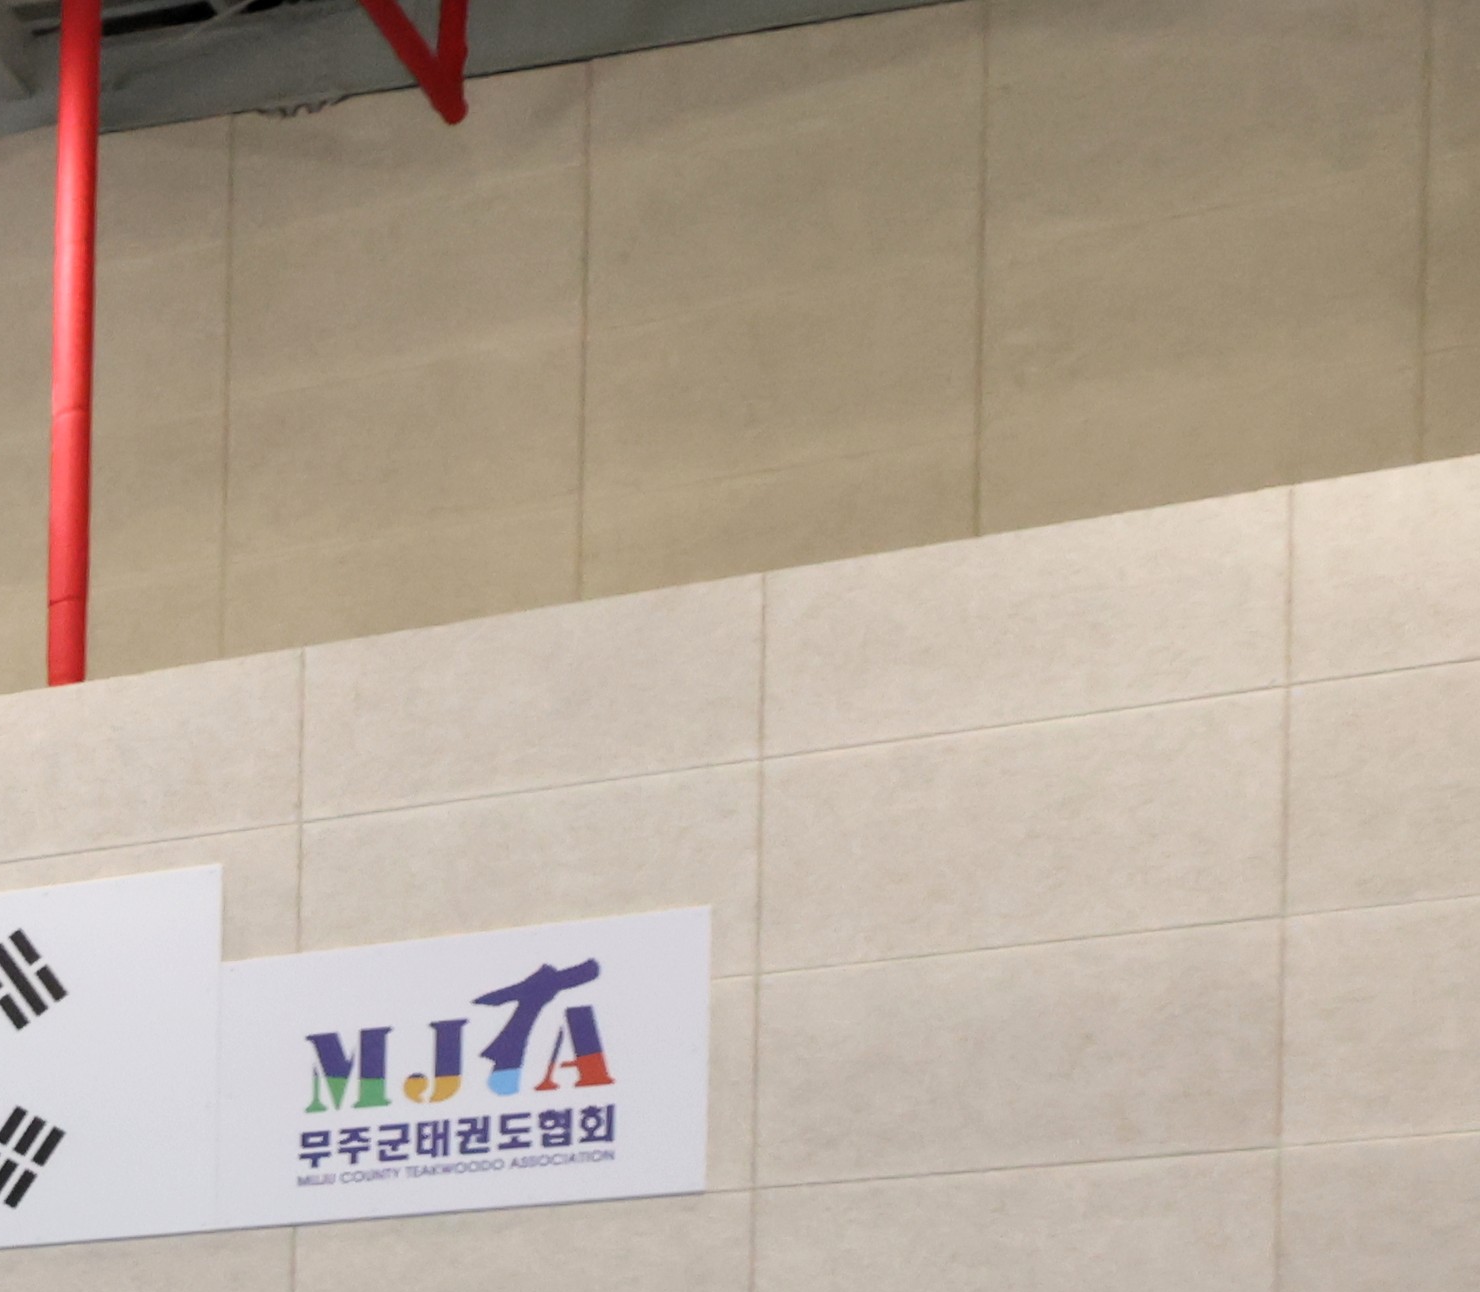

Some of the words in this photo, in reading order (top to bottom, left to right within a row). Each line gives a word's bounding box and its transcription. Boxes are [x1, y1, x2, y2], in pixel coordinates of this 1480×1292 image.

[305, 958, 615, 1114] MJTA
[297, 1173, 336, 1186] MUJU
[339, 1167, 402, 1184] COUNTY
[510, 1149, 616, 1169] ASSOCIATION
[299, 1104, 616, 1169] 무주군태권도협회
